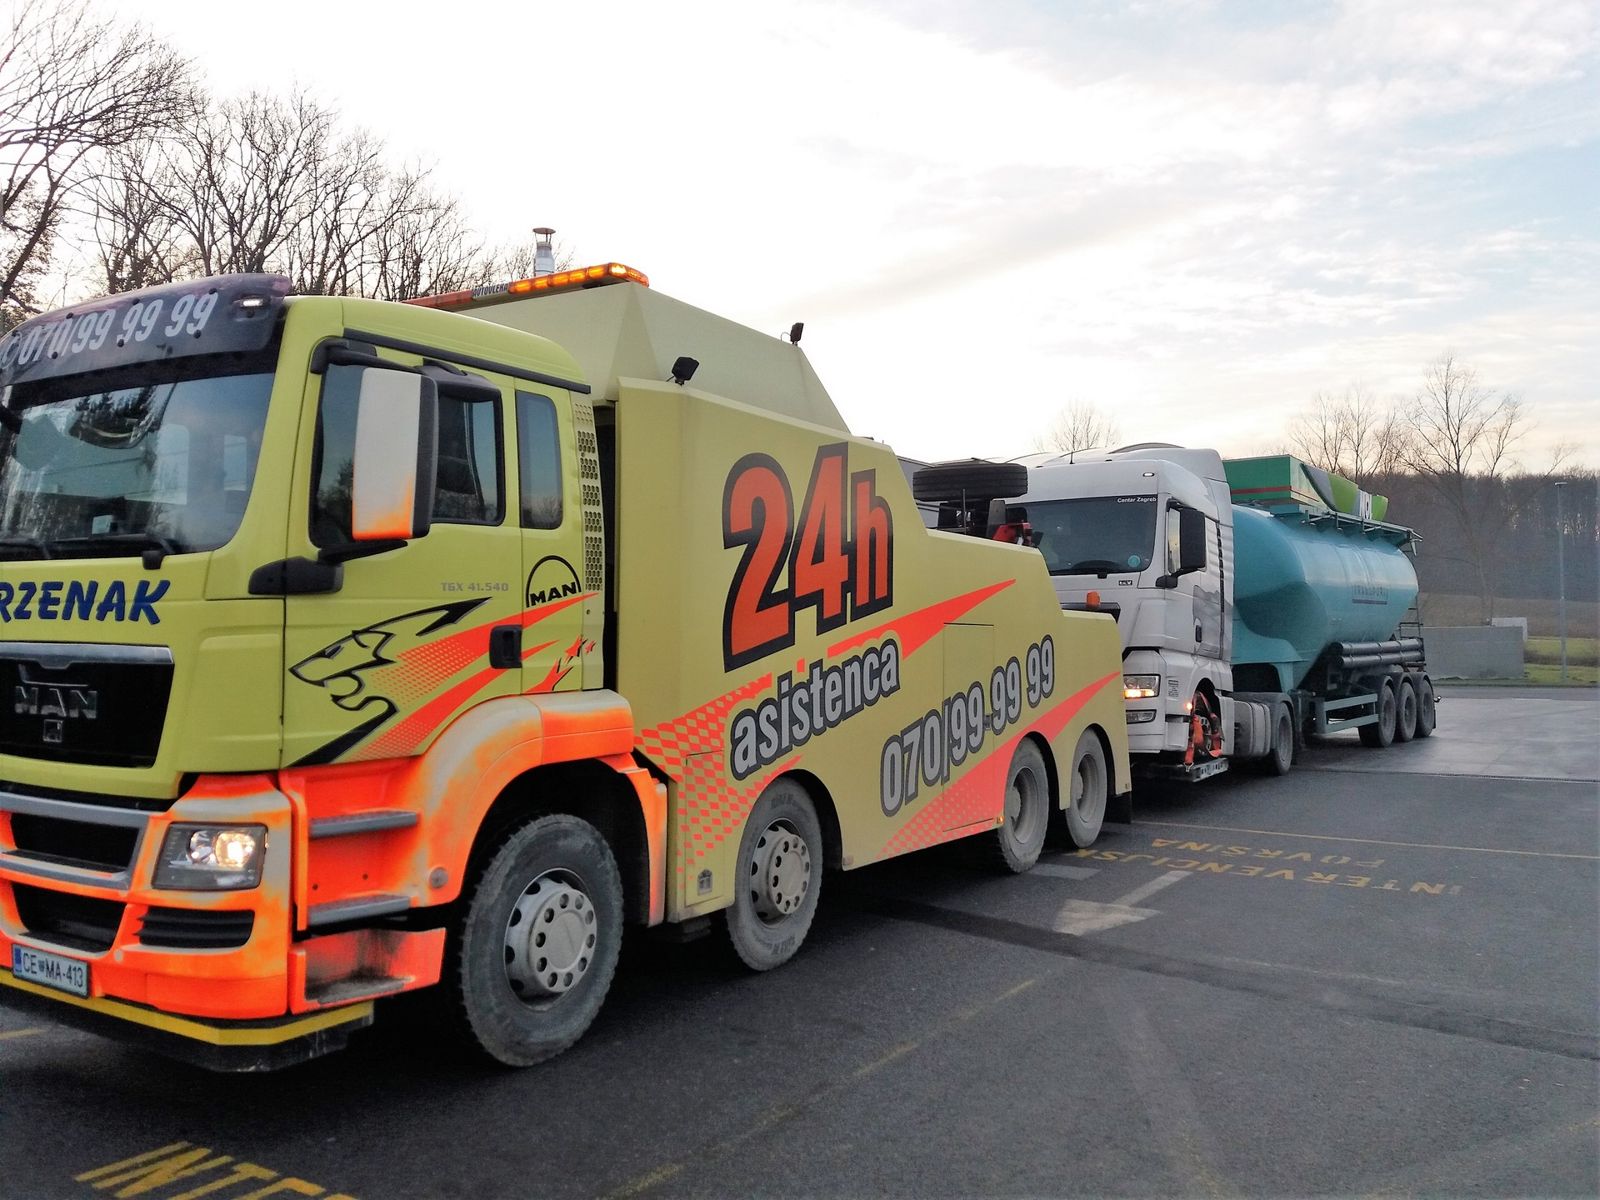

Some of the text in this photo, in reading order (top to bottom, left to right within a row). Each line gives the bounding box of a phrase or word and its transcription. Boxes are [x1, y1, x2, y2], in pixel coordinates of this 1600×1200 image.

[117, 299, 164, 343] 99
[165, 293, 218, 337] 99
[722, 442, 893, 673] 24h
[441, 582, 509, 592] TGX 41.540
[529, 581, 577, 606] MAN
[15, 686, 98, 719] MAN
[730, 634, 900, 781] asistenca
[880, 634, 1054, 817] 070/99 99 99
[1066, 848, 1462, 895] INTERVENCIJSK
[22, 952, 84, 988] CE MA-413
